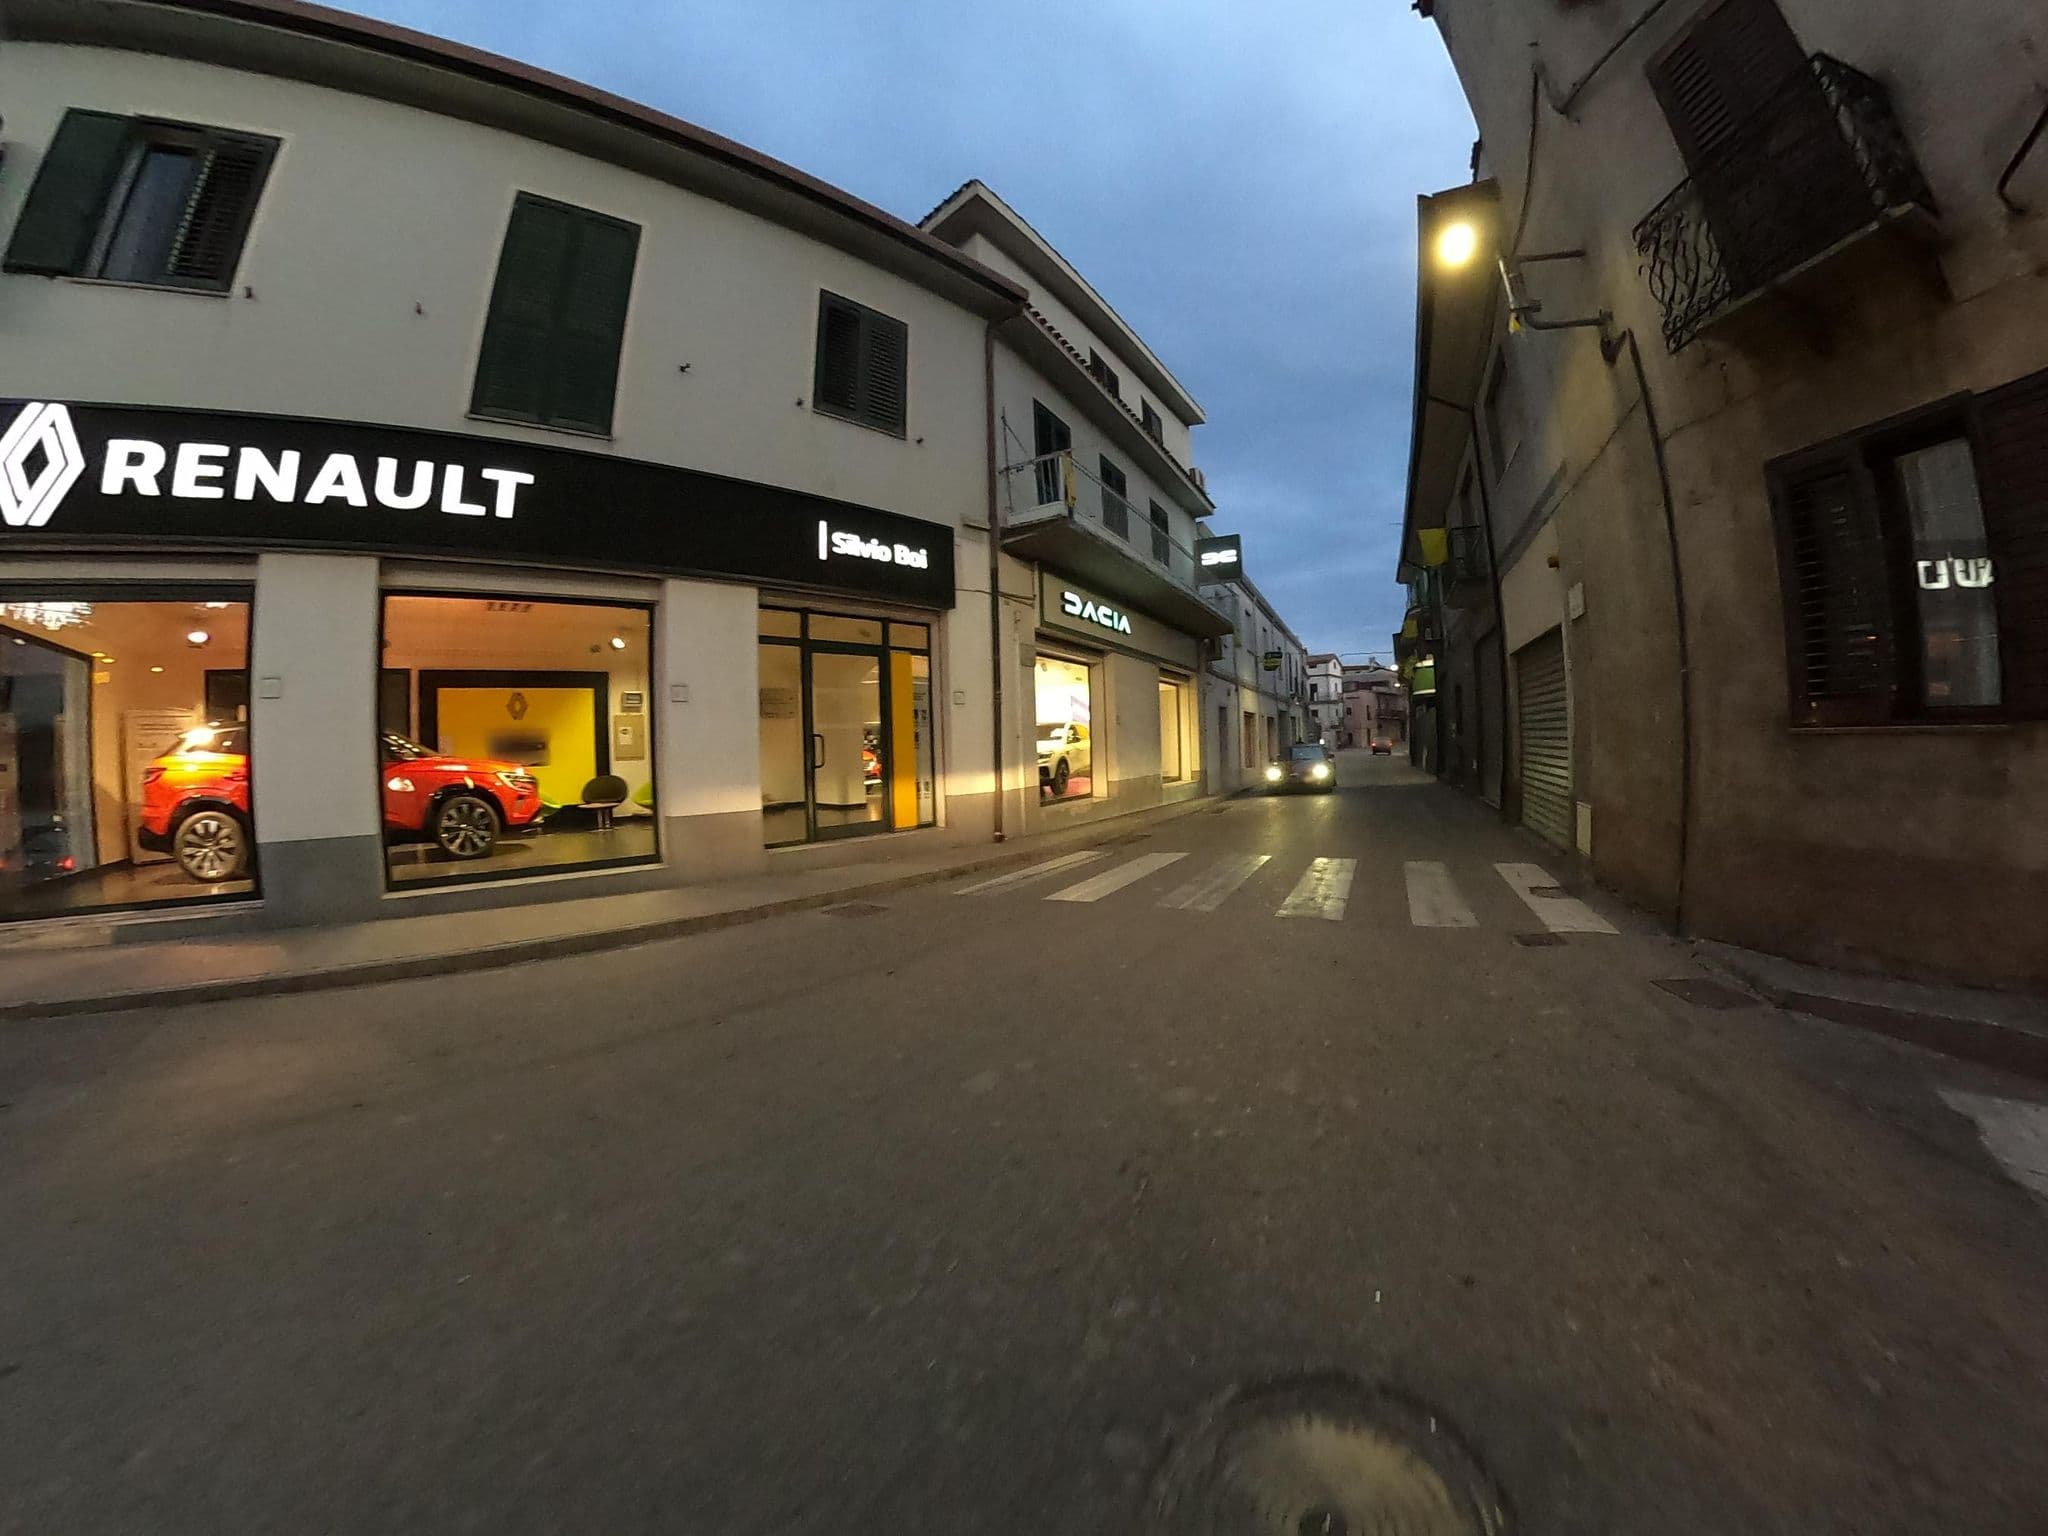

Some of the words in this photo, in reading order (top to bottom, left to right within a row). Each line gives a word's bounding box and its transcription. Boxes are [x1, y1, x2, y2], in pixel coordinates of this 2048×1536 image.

[100, 438, 537, 520] RENAULT
[893, 543, 929, 569] Boi
[1064, 591, 1132, 634] DACIA
